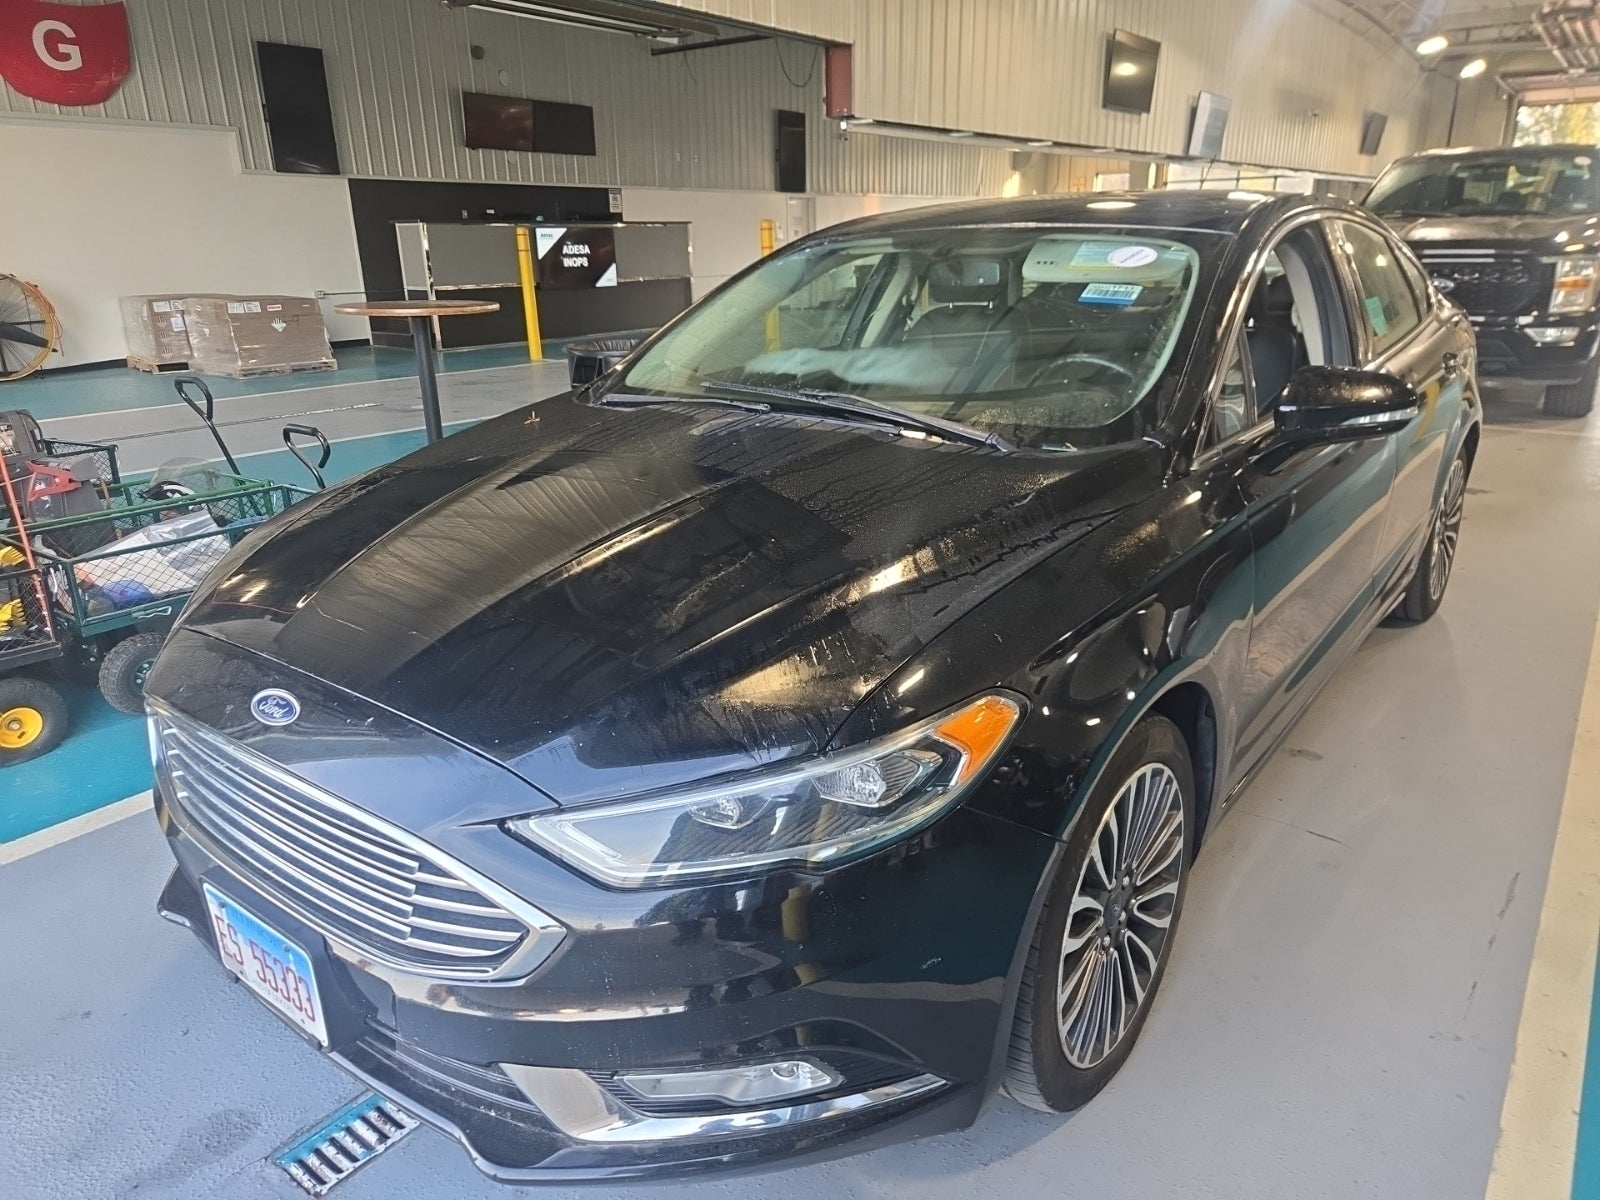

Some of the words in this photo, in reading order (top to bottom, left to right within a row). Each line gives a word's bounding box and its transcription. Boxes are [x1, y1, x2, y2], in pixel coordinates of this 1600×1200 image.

[32, 19, 83, 71] G
[562, 244, 591, 255] ADESA
[563, 257, 589, 268] INOPS
[259, 696, 289, 718] Ford
[214, 913, 244, 966] ES
[249, 938, 316, 1023] 55333
